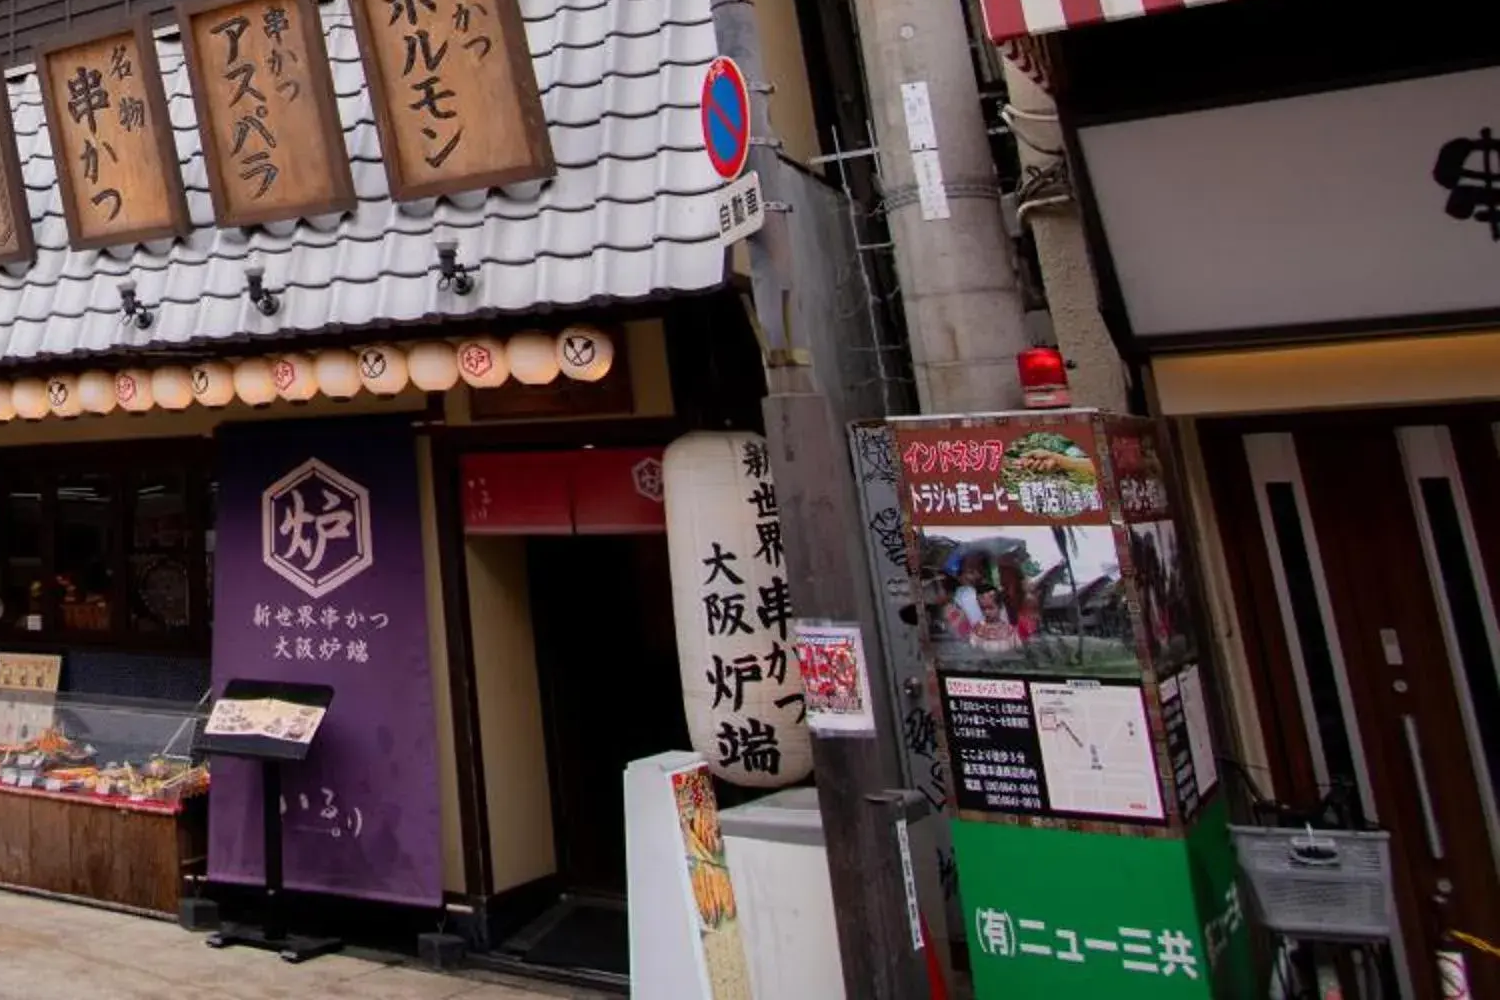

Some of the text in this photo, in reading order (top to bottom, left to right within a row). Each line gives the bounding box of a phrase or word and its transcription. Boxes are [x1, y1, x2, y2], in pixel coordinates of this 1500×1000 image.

[263, 5, 299, 103] 串かつ
[67, 66, 122, 224] 串かつ
[210, 15, 279, 198] アスパラ
[903, 440, 1003, 473] インドネシア
[279, 489, 354, 571] 炉
[253, 603, 390, 630] 新世界串かつ
[742, 442, 806, 724] 新世界串かつ
[273, 636, 369, 663] 大阪炉端
[701, 541, 781, 776] 大阪炉端
[976, 907, 1199, 980] (有)ニュー三共
